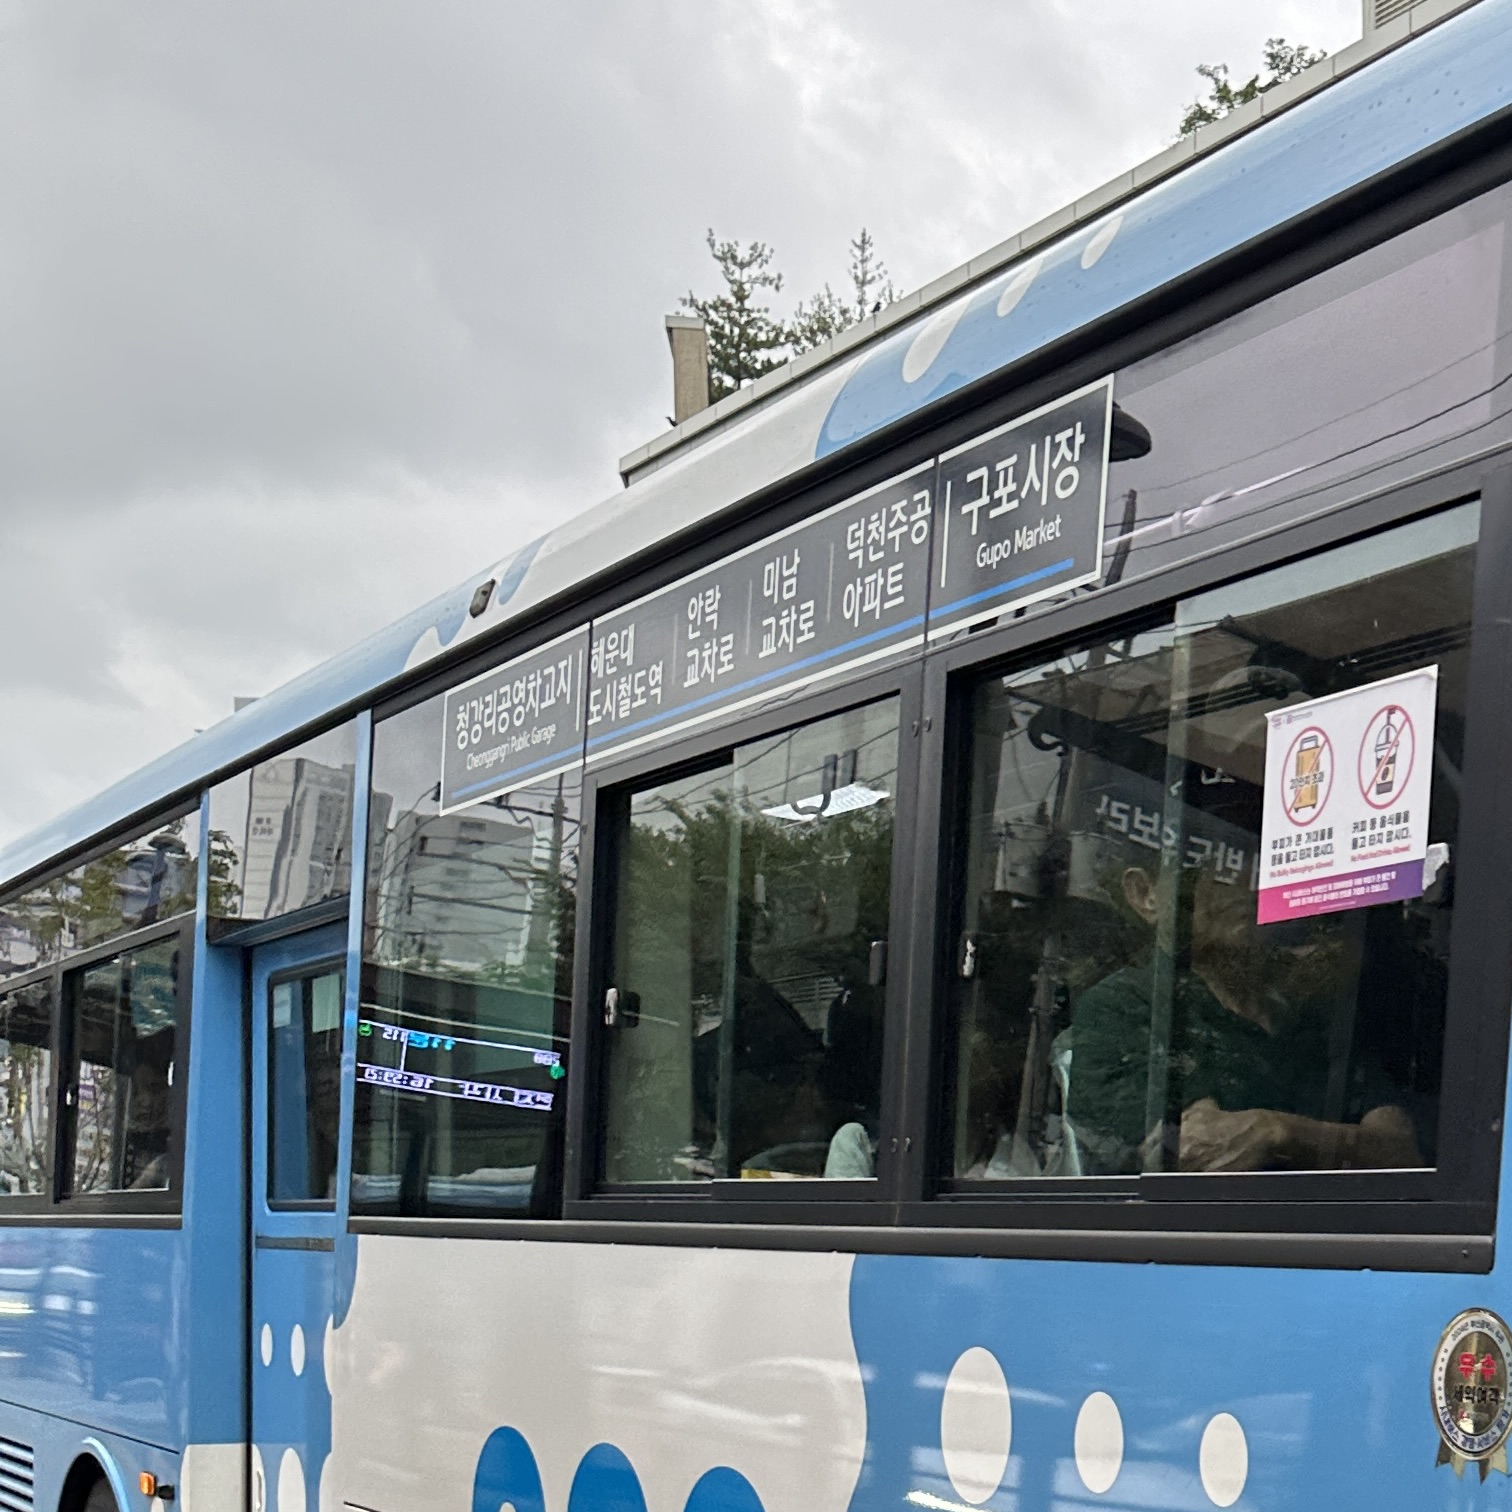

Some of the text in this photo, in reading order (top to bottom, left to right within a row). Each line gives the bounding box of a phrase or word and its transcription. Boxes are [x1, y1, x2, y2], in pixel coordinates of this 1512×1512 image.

[961, 421, 1086, 536] 구포시장
[846, 489, 932, 569] 덕천주공
[976, 513, 1062, 569] Gupo Market
[763, 548, 801, 605] 미남
[842, 562, 905, 628] 아파트
[687, 584, 722, 640] 안락
[758, 599, 816, 660] 교차로
[591, 623, 635, 679] 해운대
[683, 633, 735, 689] 교차로
[456, 654, 573, 750] 청강리공영차고지
[587, 660, 664, 727] 도시철도역
